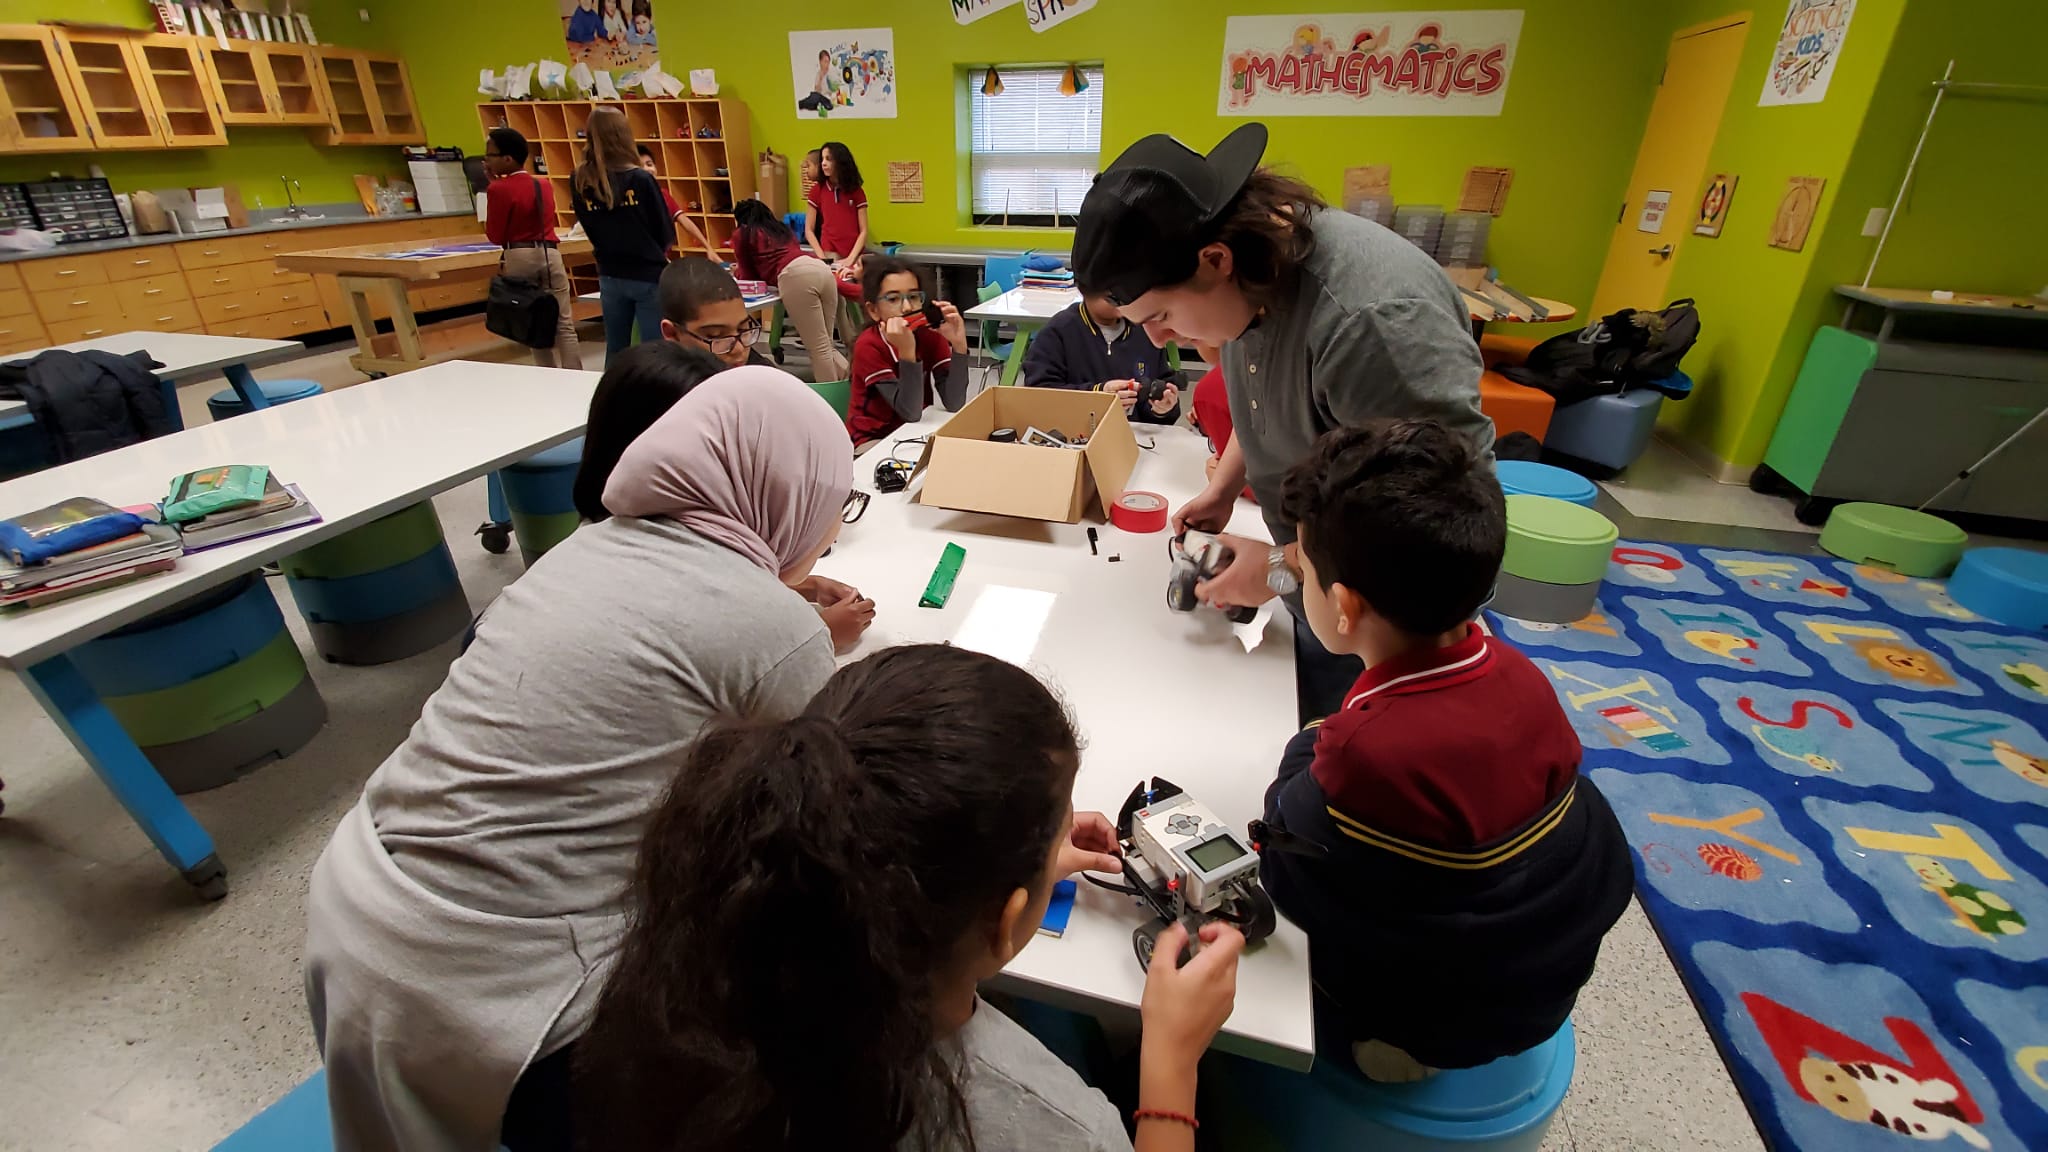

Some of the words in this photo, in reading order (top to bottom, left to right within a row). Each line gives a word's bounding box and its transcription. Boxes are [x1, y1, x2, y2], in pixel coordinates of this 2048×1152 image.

[1802, 621, 1900, 644] L
[1550, 664, 1678, 723] X
[1736, 696, 1853, 729] S
[1648, 808, 1801, 865] Y
[1844, 824, 2015, 881] T
